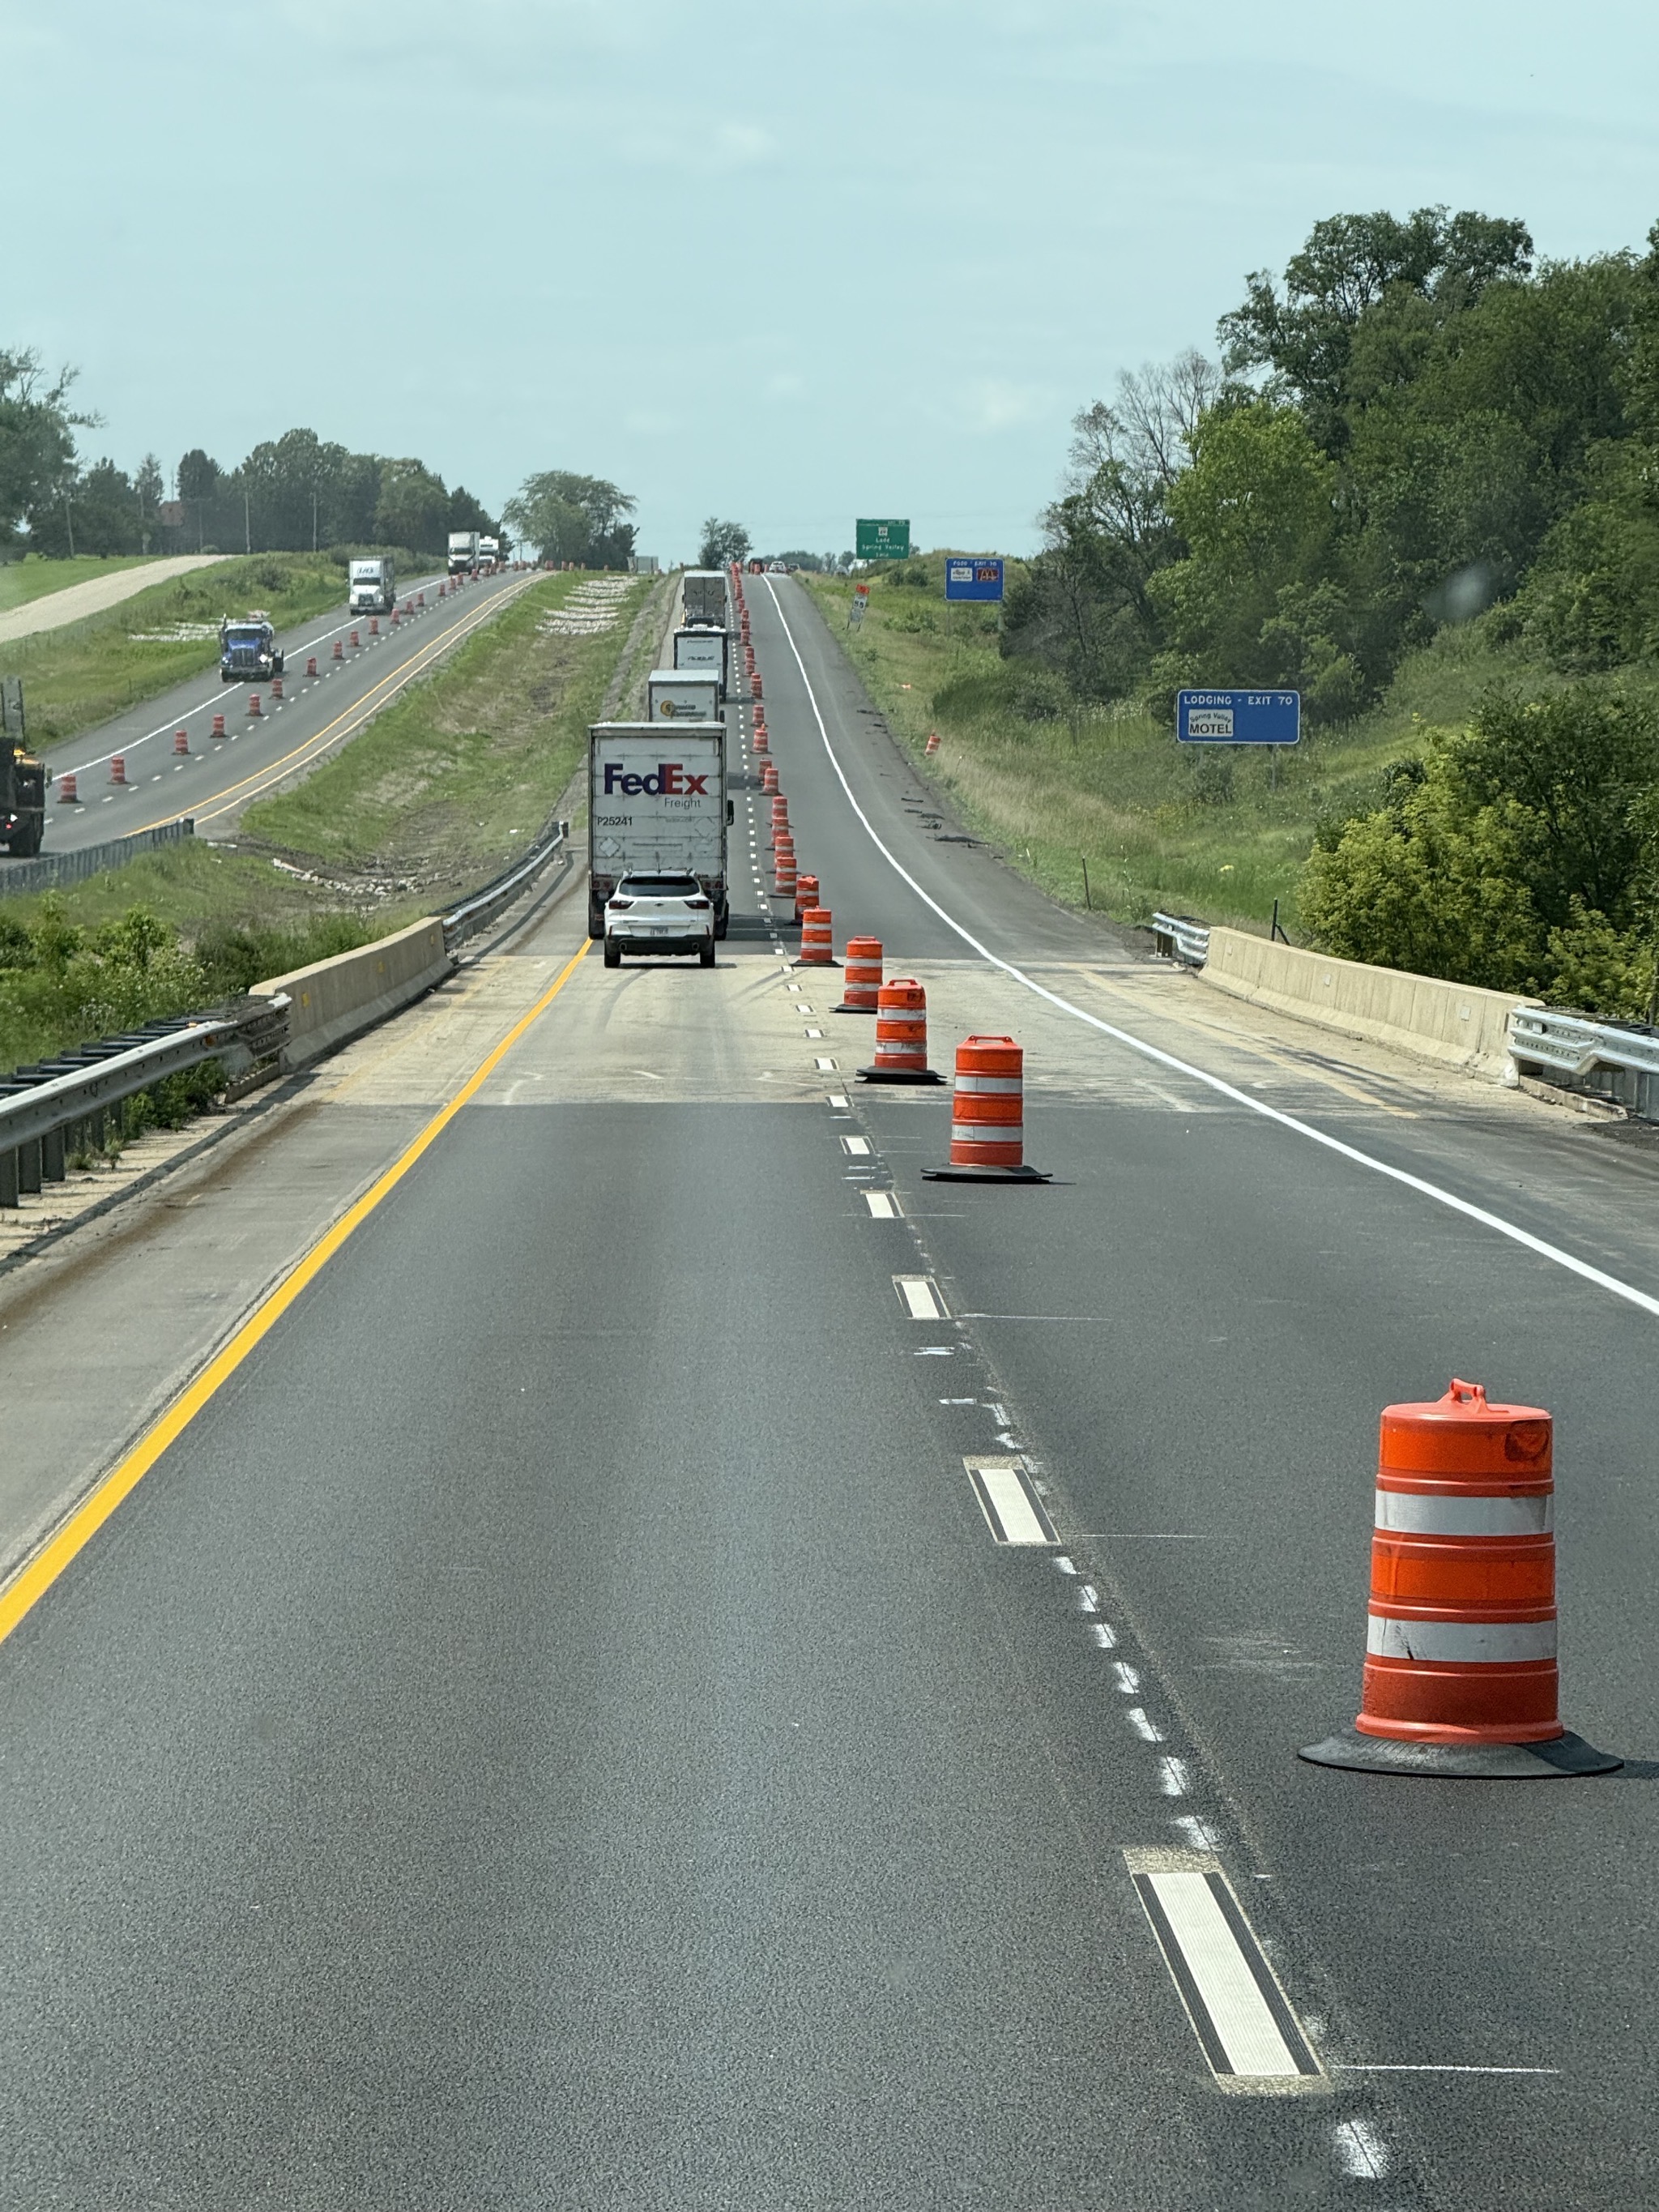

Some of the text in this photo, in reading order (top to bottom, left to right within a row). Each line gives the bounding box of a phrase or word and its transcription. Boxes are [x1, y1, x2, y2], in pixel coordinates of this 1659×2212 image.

[1183, 695, 1232, 705] LODGING
[1247, 696, 1272, 705] EXIT
[1277, 696, 1293, 705] 70
[1190, 712, 1231, 724] Spring Valley
[1189, 724, 1232, 734] MOTEL
[604, 763, 709, 796] FedEx
[664, 797, 702, 809] Freight
[597, 816, 633, 826] P25241
